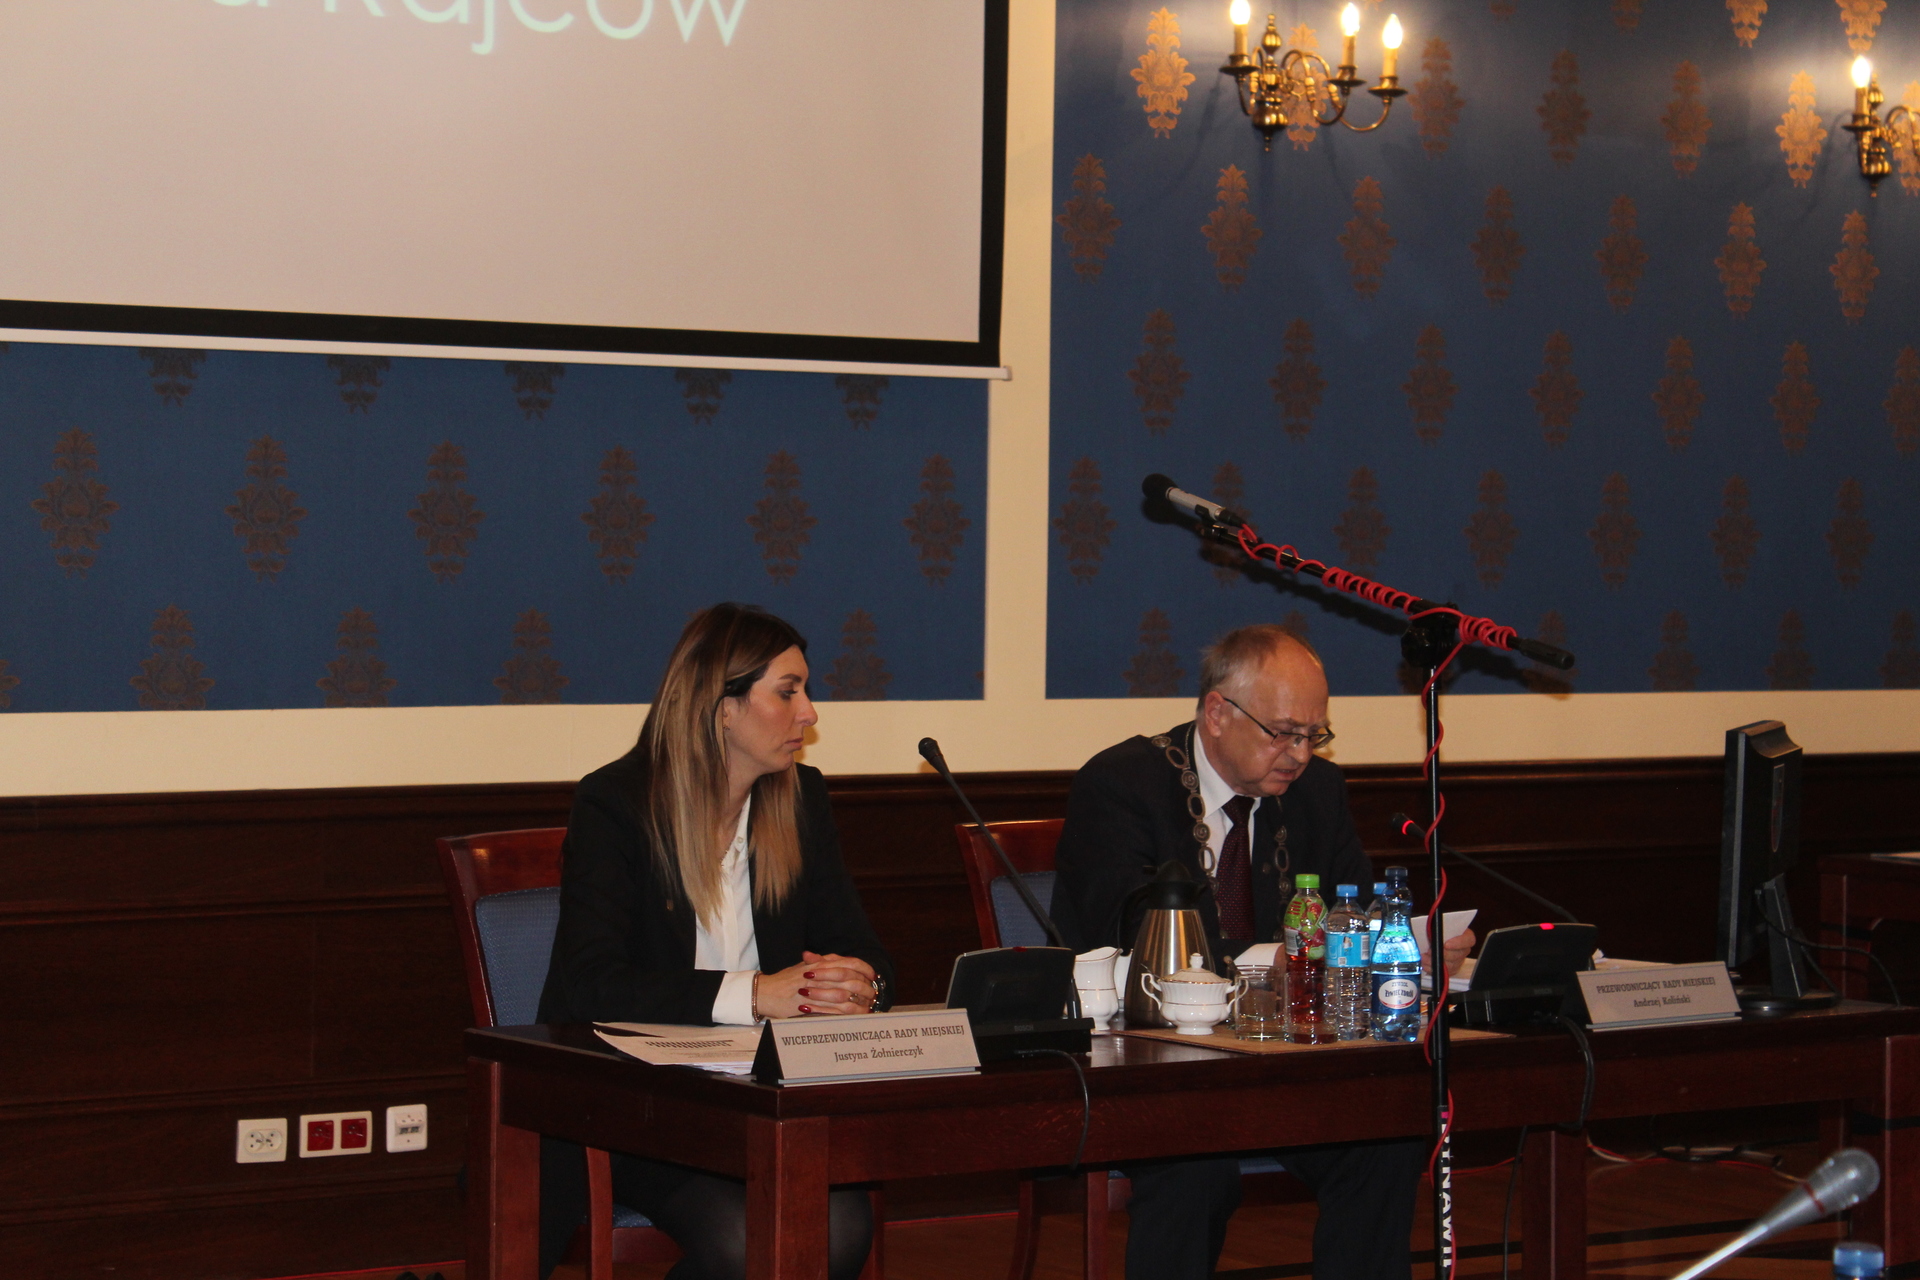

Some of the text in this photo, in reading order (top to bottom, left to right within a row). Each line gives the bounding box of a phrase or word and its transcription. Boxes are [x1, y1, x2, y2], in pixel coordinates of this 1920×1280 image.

[1596, 981, 1660, 994] PRZEWODNICZĄCY
[1662, 979, 1681, 989] RADY
[1633, 996, 1661, 1007] Andrzej
[781, 1025, 965, 1046] WICEPRZEWODNICZĄCA RADY MIEJSKIEJ
[834, 1045, 924, 1062] Justyna Żołnierczyk
